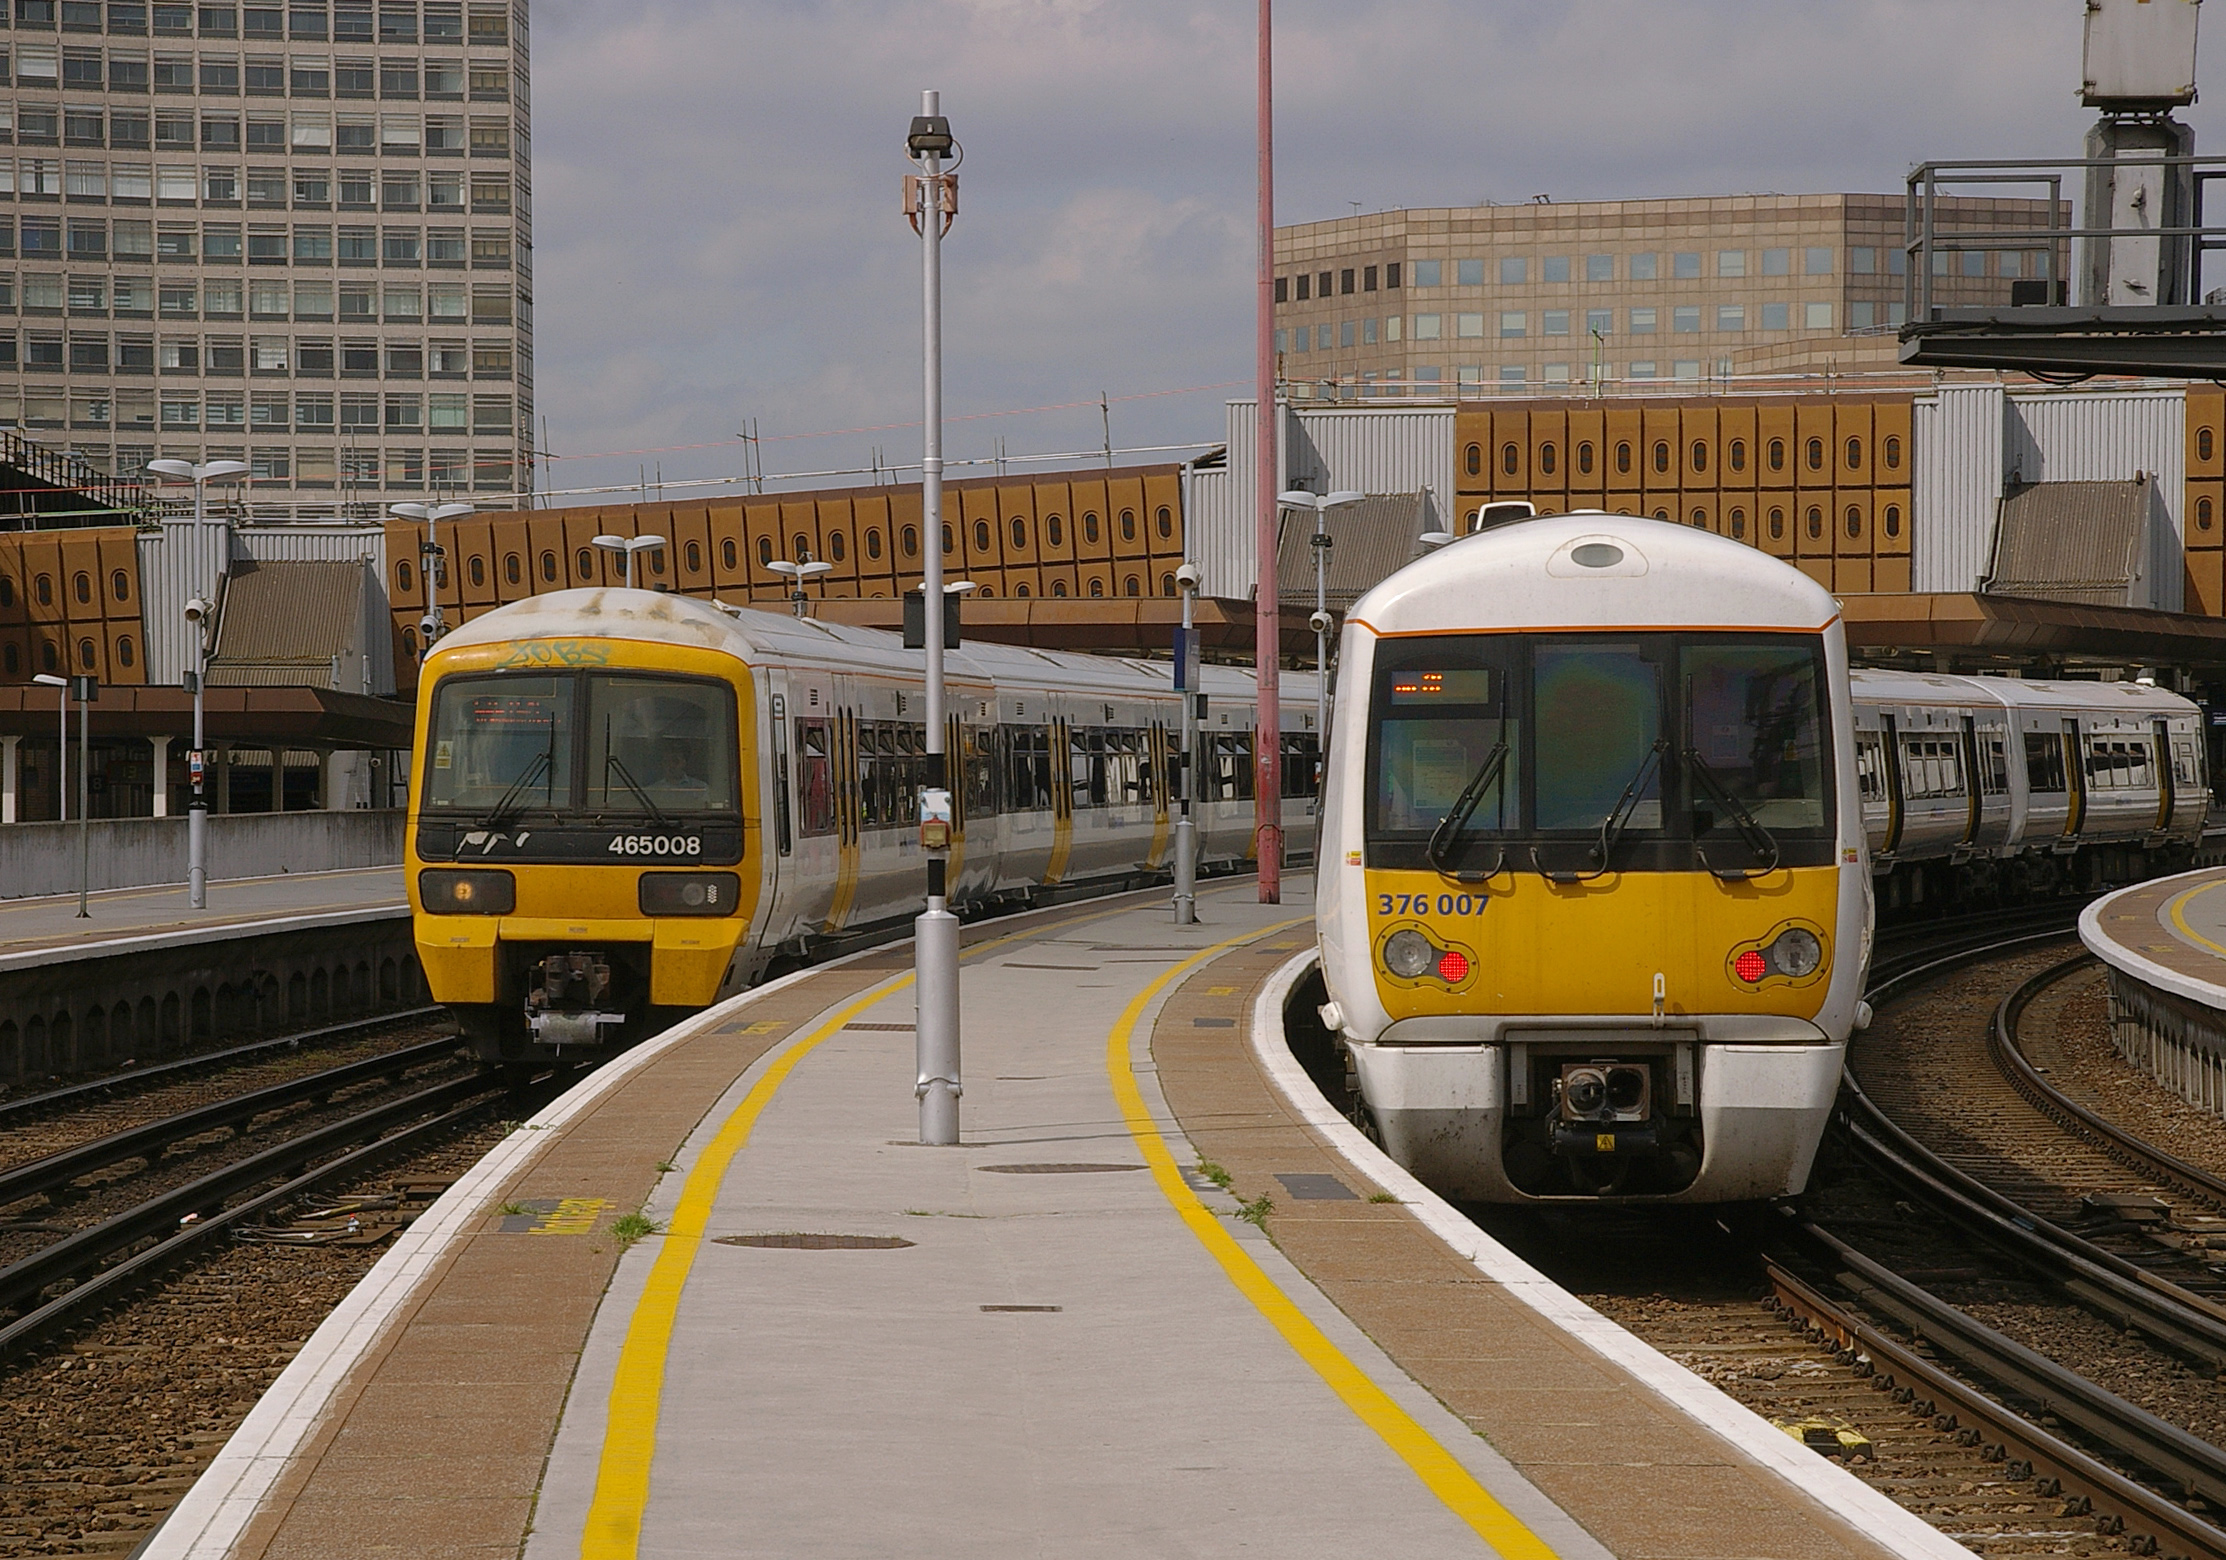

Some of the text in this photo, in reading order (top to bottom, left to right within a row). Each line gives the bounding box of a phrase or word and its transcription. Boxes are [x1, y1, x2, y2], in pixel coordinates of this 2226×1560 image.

[93, 777, 102, 790] 8
[608, 835, 701, 855] 465008
[1378, 893, 1490, 916] 376 007
